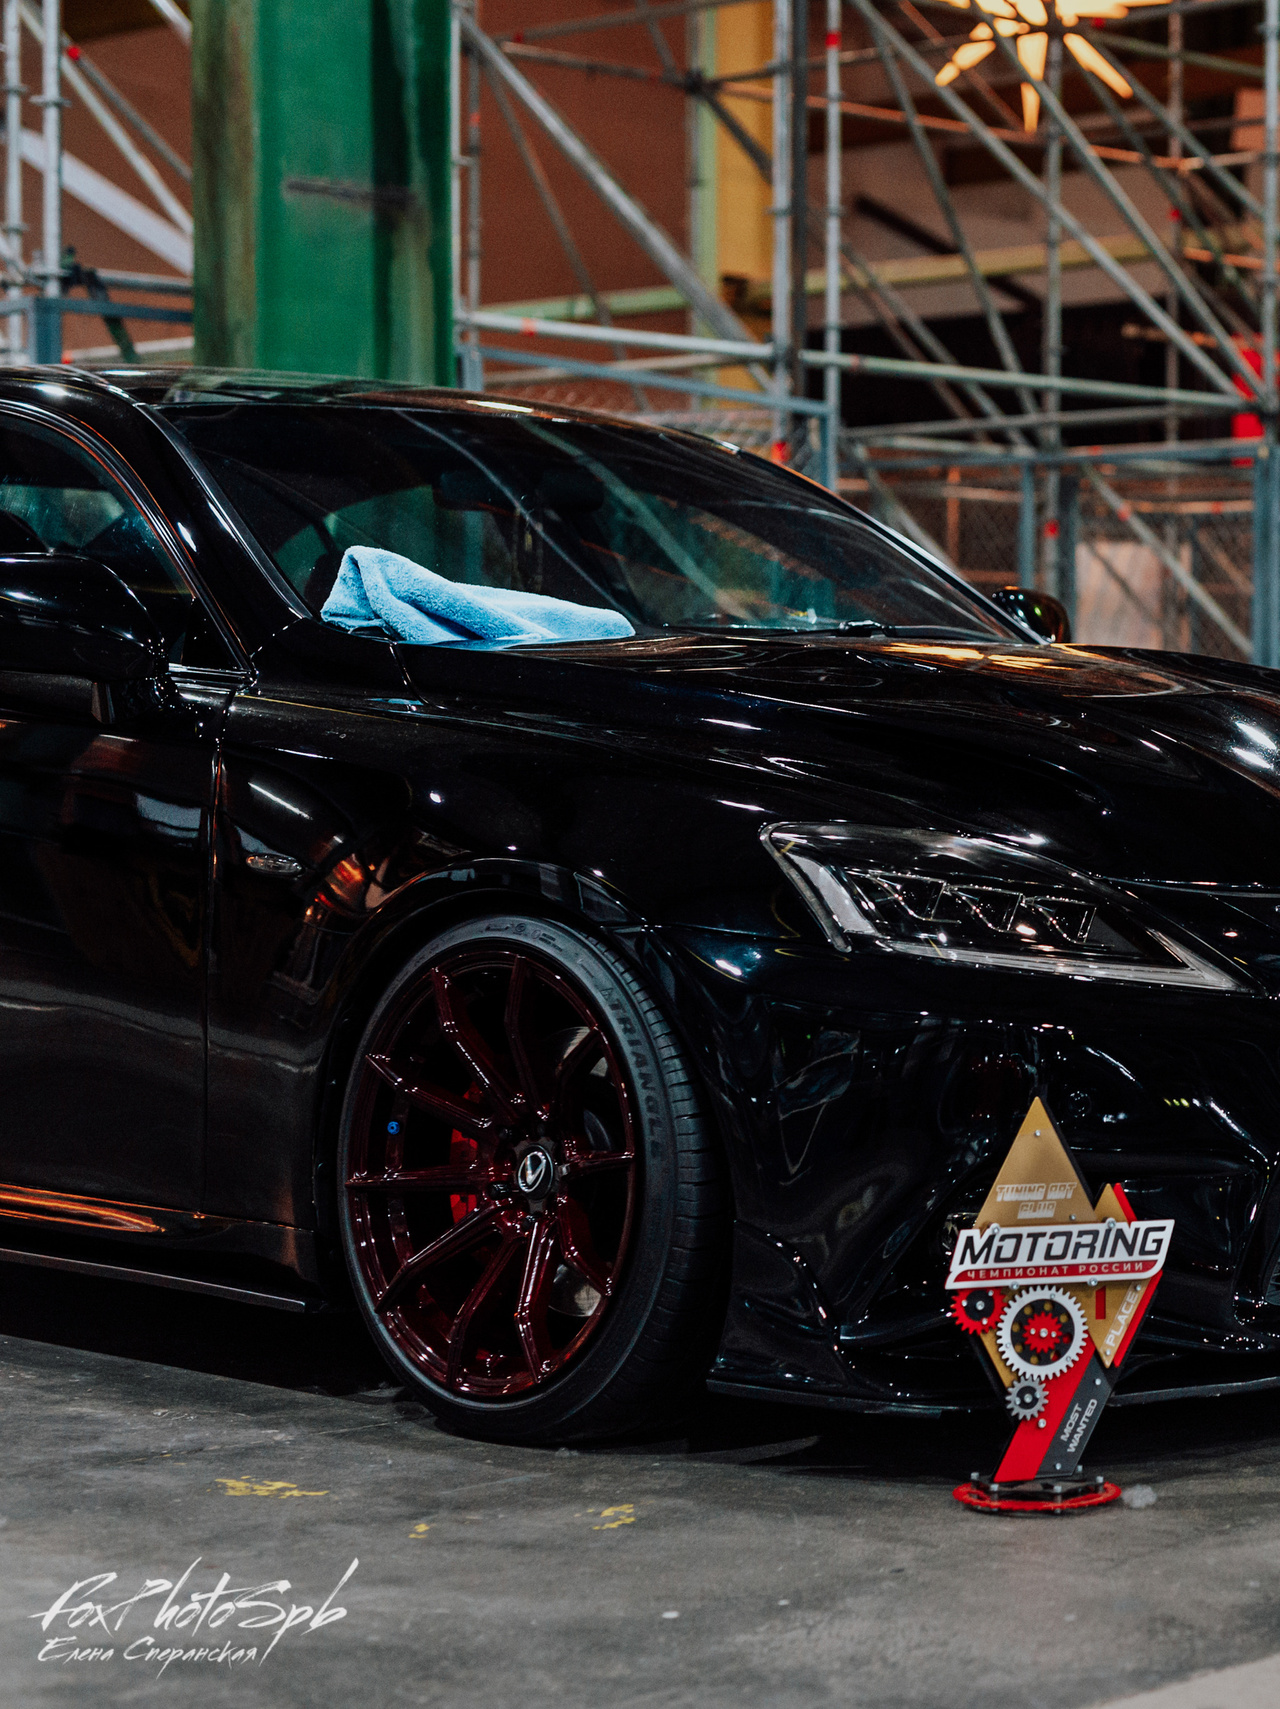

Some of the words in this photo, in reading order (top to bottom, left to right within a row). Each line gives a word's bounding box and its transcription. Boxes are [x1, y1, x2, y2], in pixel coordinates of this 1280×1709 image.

[996, 1183, 1047, 1202] TUNING
[959, 1225, 1168, 1266] MOTORING
[967, 1265, 1069, 1279] ЧЕМПИОНАТ
[1079, 1262, 1144, 1274] РОССИИ
[1106, 1290, 1138, 1347] PLACE
[1060, 1403, 1083, 1442] MOST
[1067, 1399, 1098, 1453] WANTED
